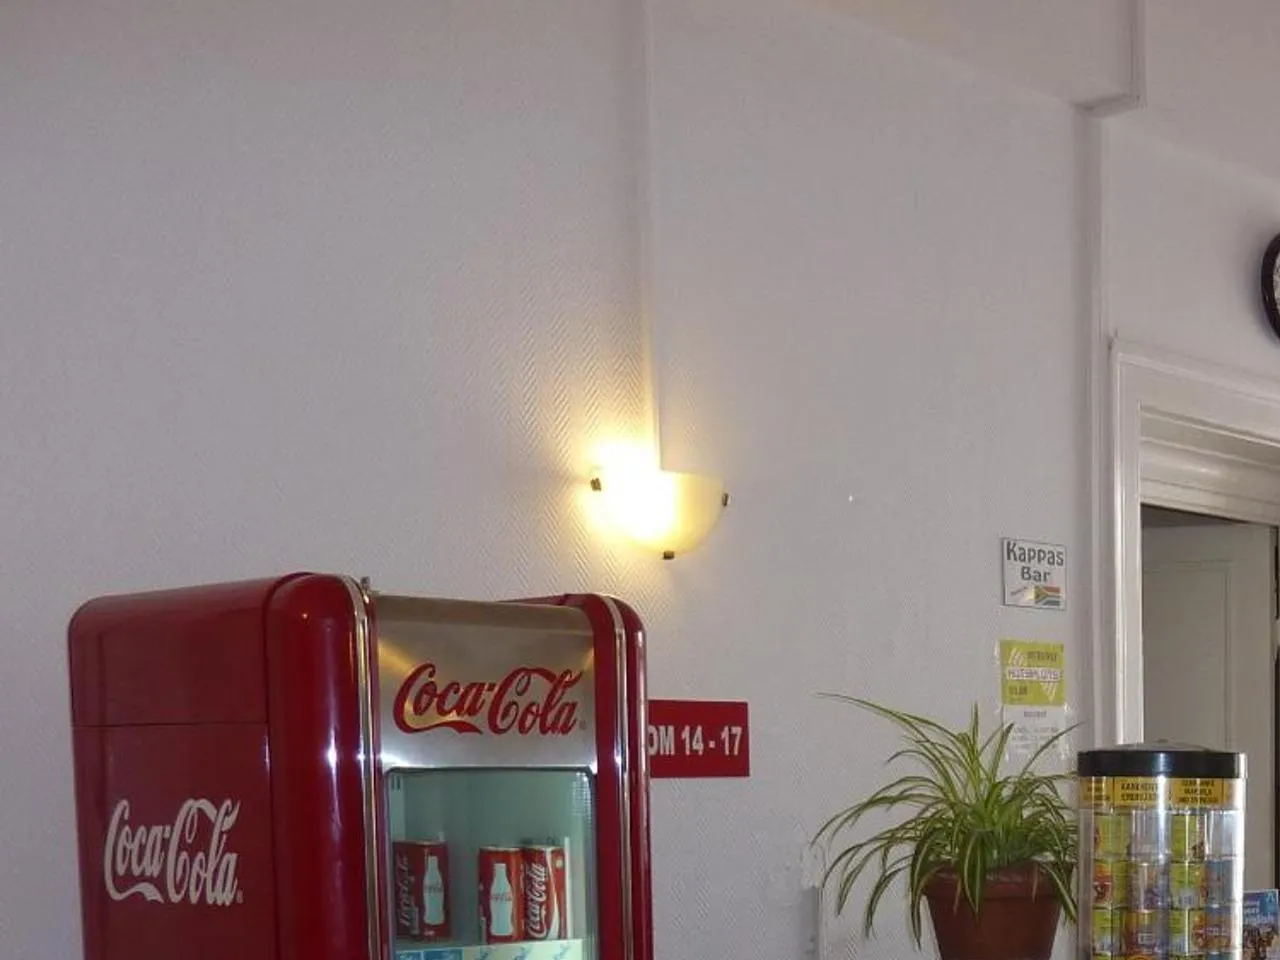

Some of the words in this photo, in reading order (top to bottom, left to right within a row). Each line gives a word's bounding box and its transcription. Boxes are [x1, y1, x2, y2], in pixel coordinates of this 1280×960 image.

[1006, 541, 1064, 566] Kappas
[1021, 566, 1051, 583] Bar
[393, 663, 582, 735] Coca-Cola
[681, 725, 704, 756] 14
[721, 725, 743, 756] 17
[104, 798, 241, 906] Coca-Cola
